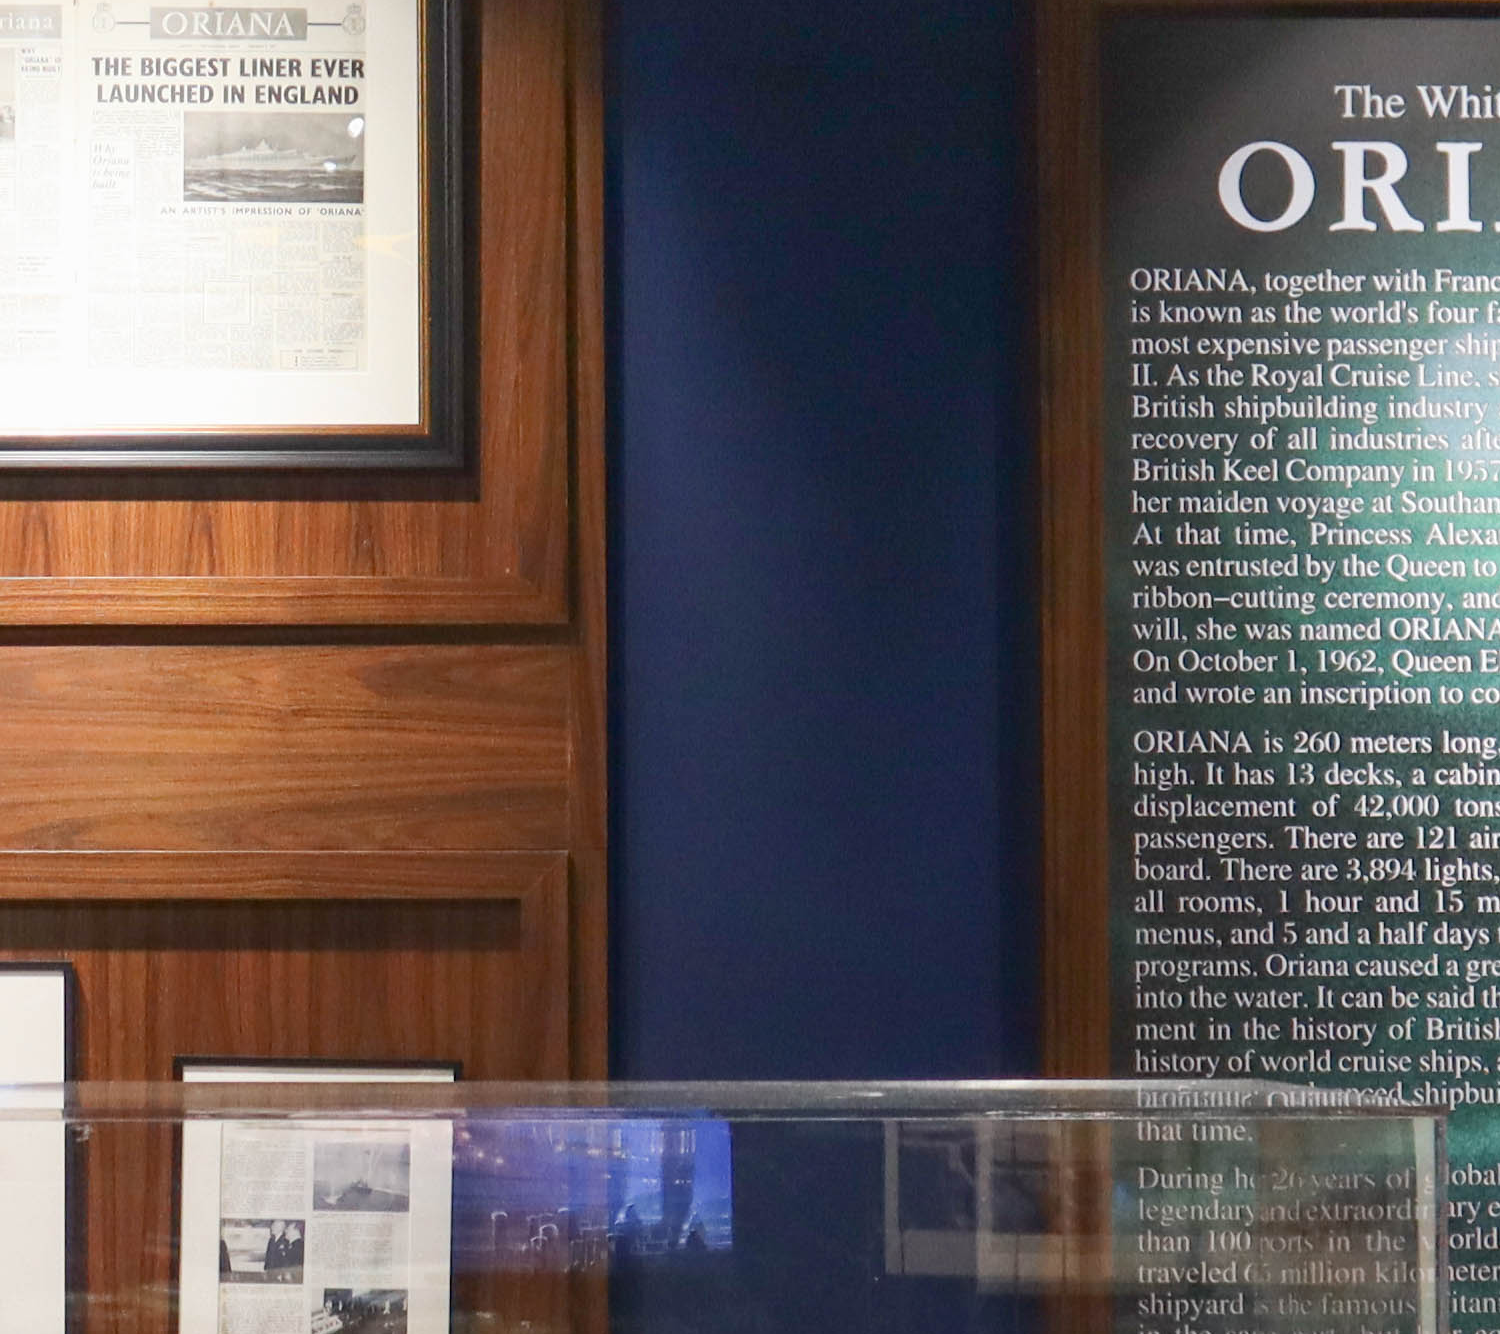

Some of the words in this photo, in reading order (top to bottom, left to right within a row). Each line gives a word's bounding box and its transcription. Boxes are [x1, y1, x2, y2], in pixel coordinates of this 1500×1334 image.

[162, 12, 295, 36] ORIANA
[92, 57, 132, 76] THE
[140, 57, 230, 77] BIGGEST
[240, 58, 303, 77] LINER
[311, 58, 365, 78] EVER
[97, 84, 214, 104] LAUNCHED
[223, 85, 245, 104] IN
[255, 85, 359, 105] ENGLAND
[1334, 86, 1405, 119] The
[1129, 267, 1257, 295] ORIANA,
[1264, 268, 1367, 298] together
[1372, 268, 1427, 293] with
[1132, 616, 1188, 644] will,
[1195, 616, 1237, 641] she
[1243, 623, 1293, 641] was
[1299, 612, 1382, 642] named
[1133, 729, 1253, 754] ORIANA
[1263, 729, 1284, 754] is
[1293, 730, 1341, 754] 260
[1349, 734, 1433, 754] meters
[1133, 789, 1296, 823] displacement
[1311, 792, 1341, 818] of
[1353, 793, 1440, 821] 42,000
